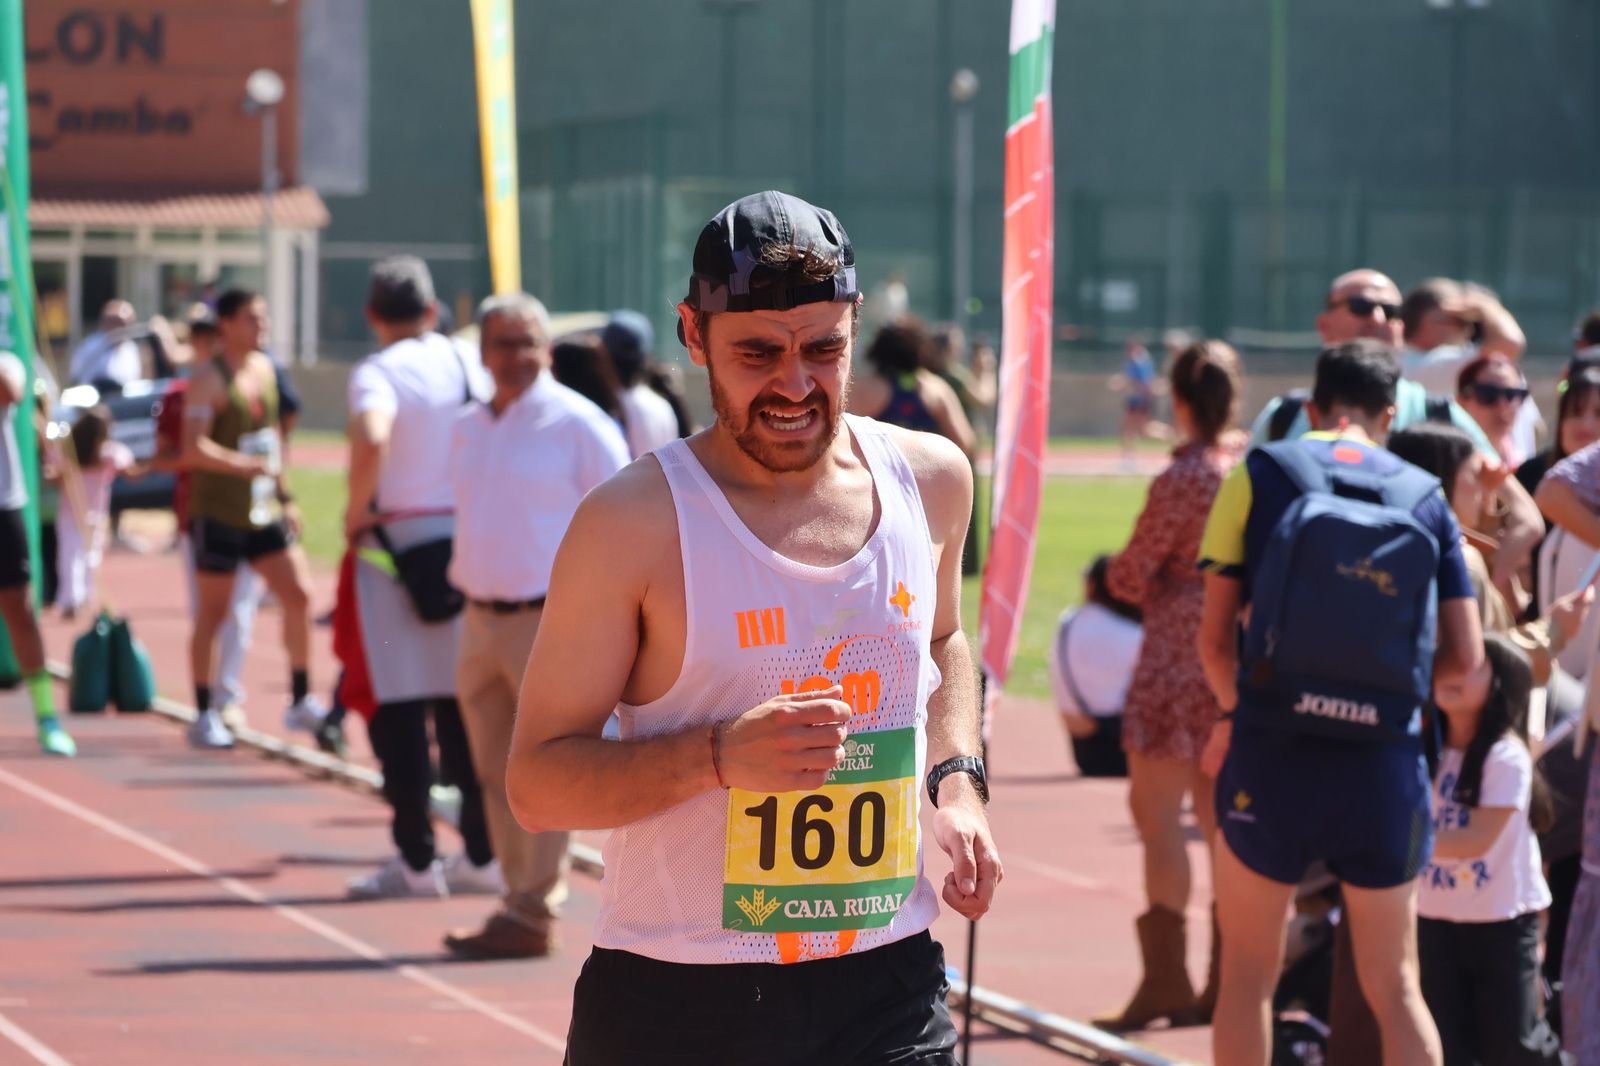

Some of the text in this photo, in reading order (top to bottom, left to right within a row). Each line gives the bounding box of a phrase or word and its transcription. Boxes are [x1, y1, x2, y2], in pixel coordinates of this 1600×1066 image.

[745, 791, 886, 871] 160
[784, 893, 903, 919] CAJA RURAL
